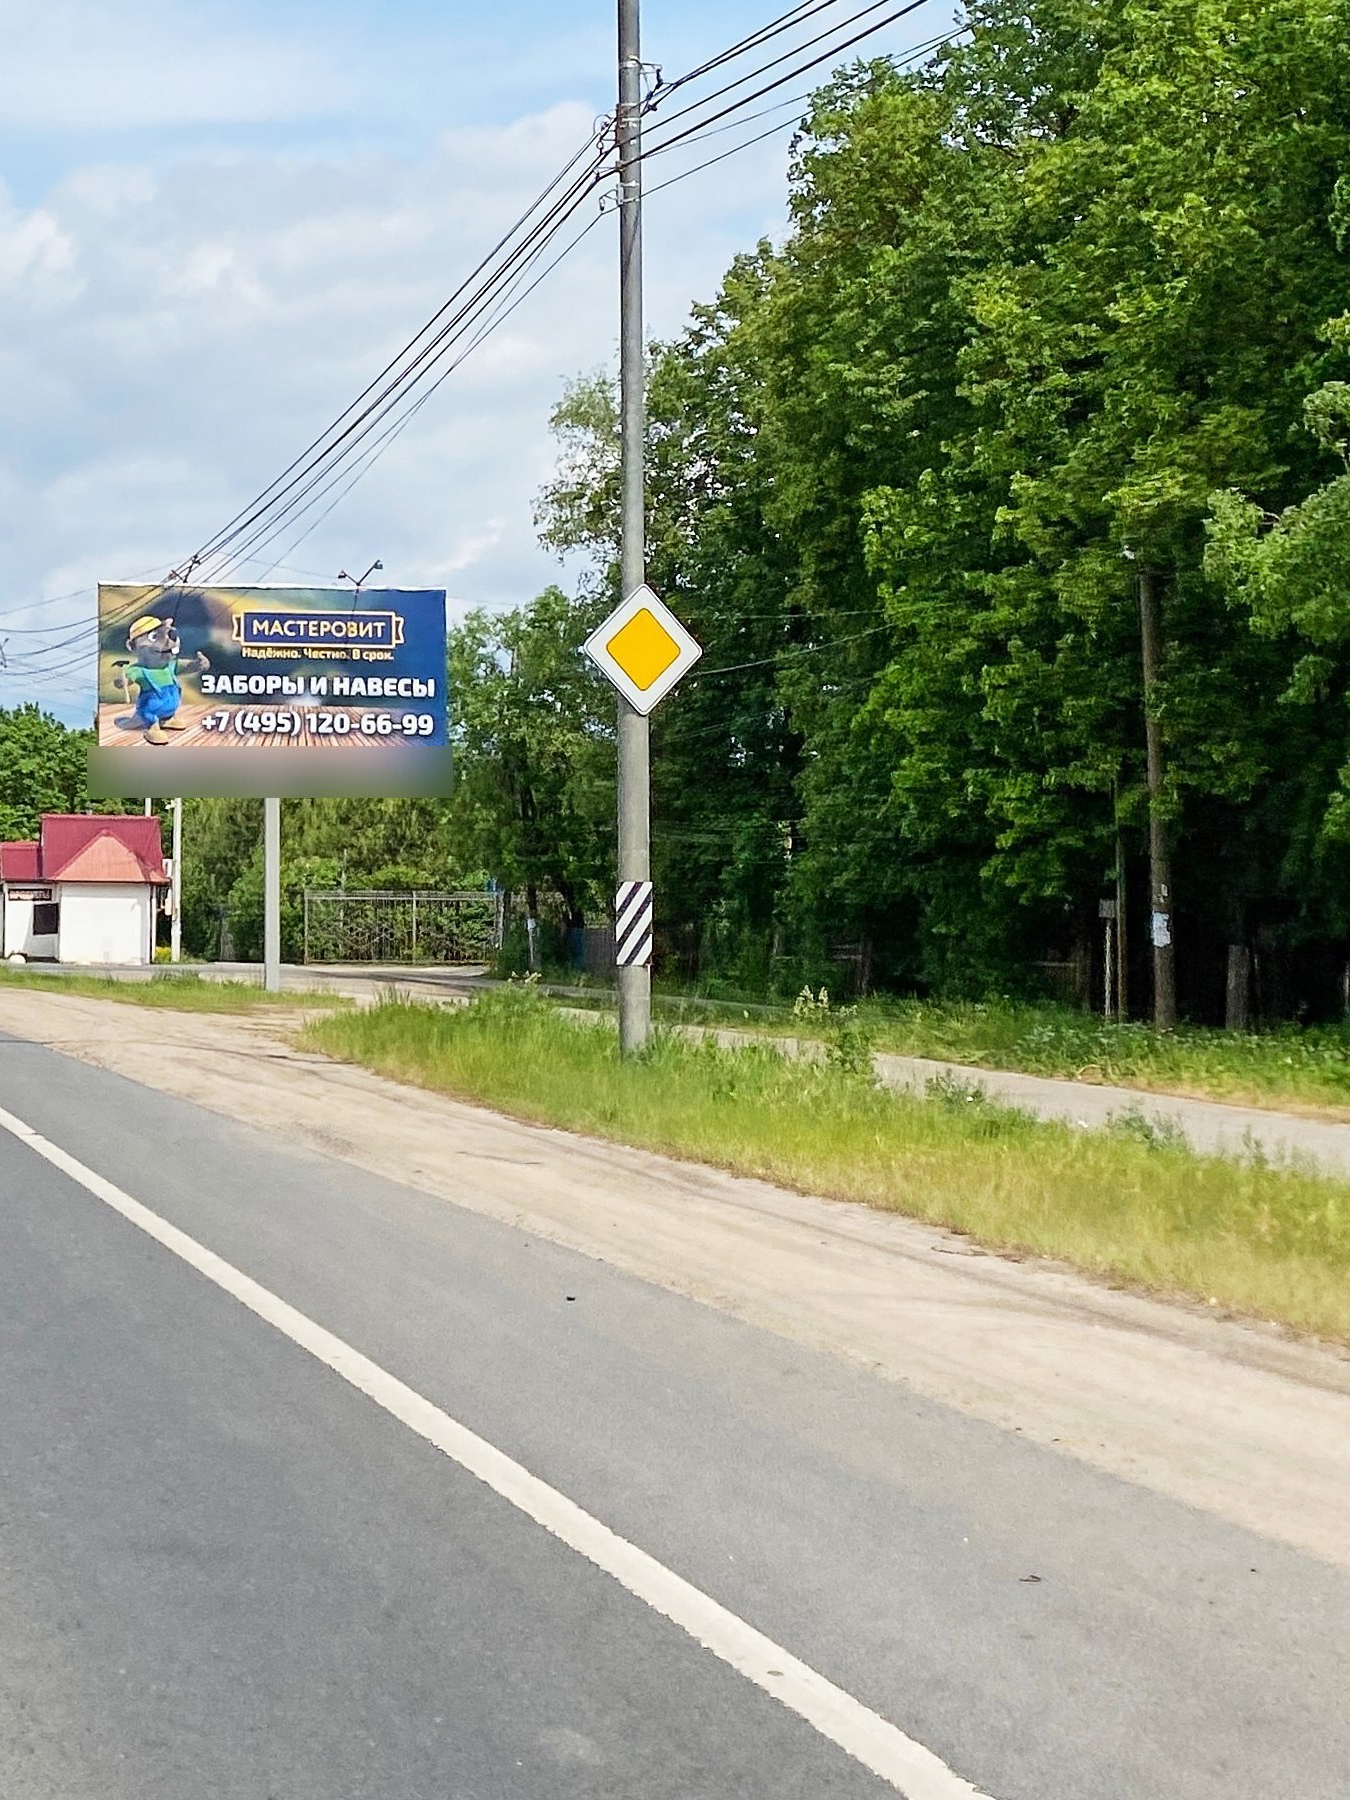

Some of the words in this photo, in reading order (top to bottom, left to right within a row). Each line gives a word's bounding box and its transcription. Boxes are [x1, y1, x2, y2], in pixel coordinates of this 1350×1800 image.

[252, 619, 386, 638] МАСТЕРОВИТ
[242, 647, 301, 660] Надёжно.
[303, 648, 350, 660] Честно.
[352, 649, 362, 660] В
[363, 651, 394, 662] срок.
[201, 674, 305, 695] ЗАБОРЫ
[310, 676, 327, 695] И
[333, 676, 436, 698] НАВЕСЫ
[201, 712, 230, 732] +7
[234, 711, 302, 736] (495)
[307, 713, 434, 736] 120-66-99
